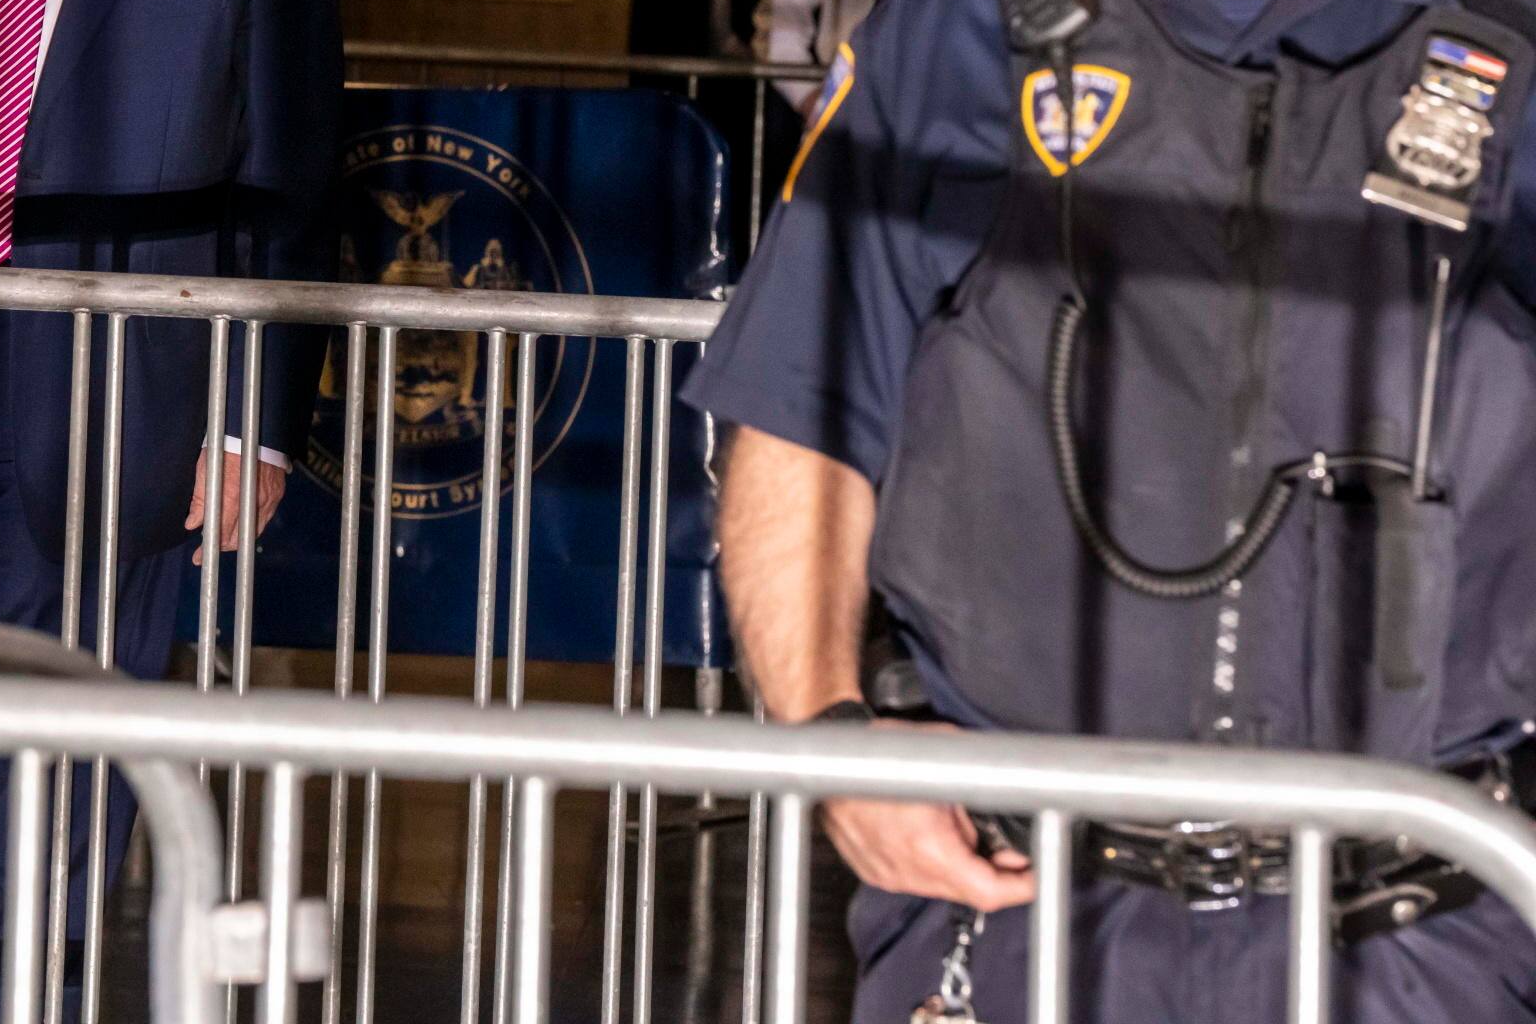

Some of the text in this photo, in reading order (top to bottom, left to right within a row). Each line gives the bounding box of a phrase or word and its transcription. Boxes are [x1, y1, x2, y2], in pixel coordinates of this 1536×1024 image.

[345, 142, 380, 167] ate
[425, 133, 474, 161] New
[484, 153, 530, 199] York
[382, 491, 440, 510] ourt
